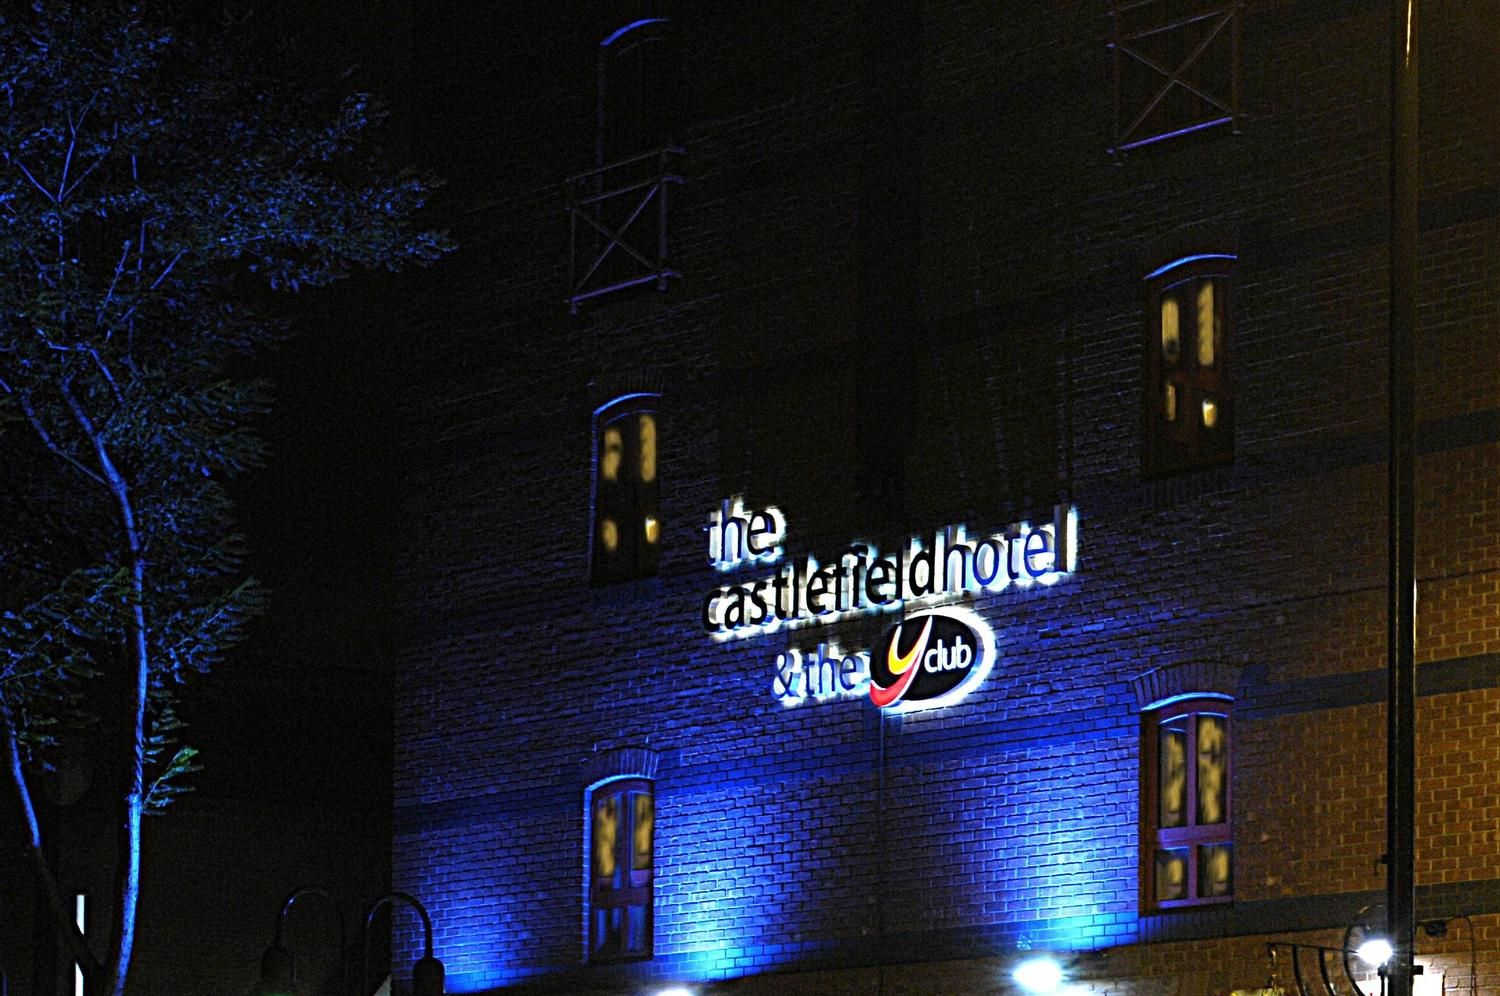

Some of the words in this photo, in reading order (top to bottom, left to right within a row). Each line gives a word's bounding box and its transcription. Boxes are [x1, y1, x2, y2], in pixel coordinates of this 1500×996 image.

[703, 498, 778, 563] the
[771, 649, 797, 699] &
[805, 643, 861, 695] the
